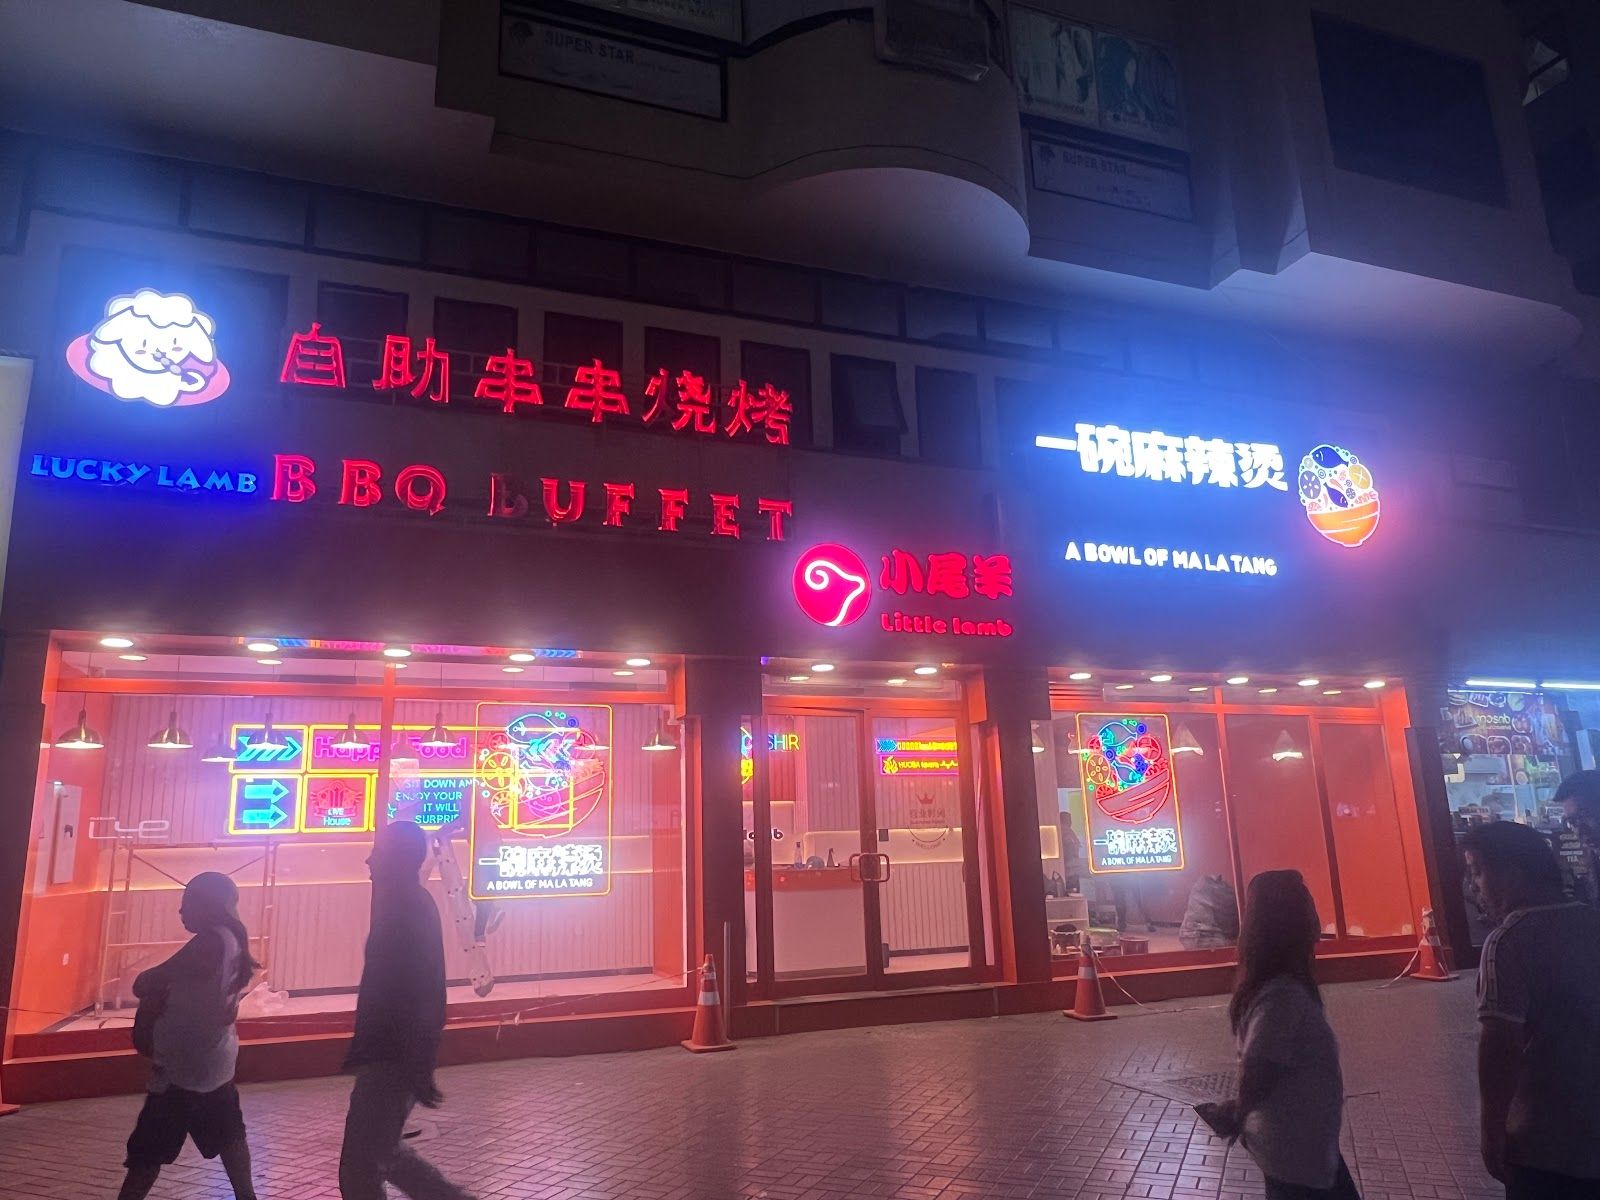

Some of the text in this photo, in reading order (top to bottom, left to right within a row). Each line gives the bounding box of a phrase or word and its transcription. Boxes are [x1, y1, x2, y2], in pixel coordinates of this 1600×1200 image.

[544, 30, 634, 65] SUPER STAR
[280, 321, 793, 445] 自助串串烧烤
[1035, 422, 1289, 492] 一碗麻辣烫
[30, 453, 258, 494] LUCKY LAMB
[270, 453, 447, 516] BBQ
[1065, 541, 1278, 576] A BOWL OF MA LA TANG
[880, 611, 1013, 637] Little lamb
[424, 779, 456, 789] DOWN
[433, 791, 462, 801] YOUR
[424, 803, 459, 812] IT WILL
[1107, 856, 1125, 866] BOWL
[1126, 856, 1135, 865] OF
[487, 881, 495, 890] A
[495, 879, 523, 890] BOWL
[525, 879, 537, 889] OF
[569, 878, 593, 888] TANG
